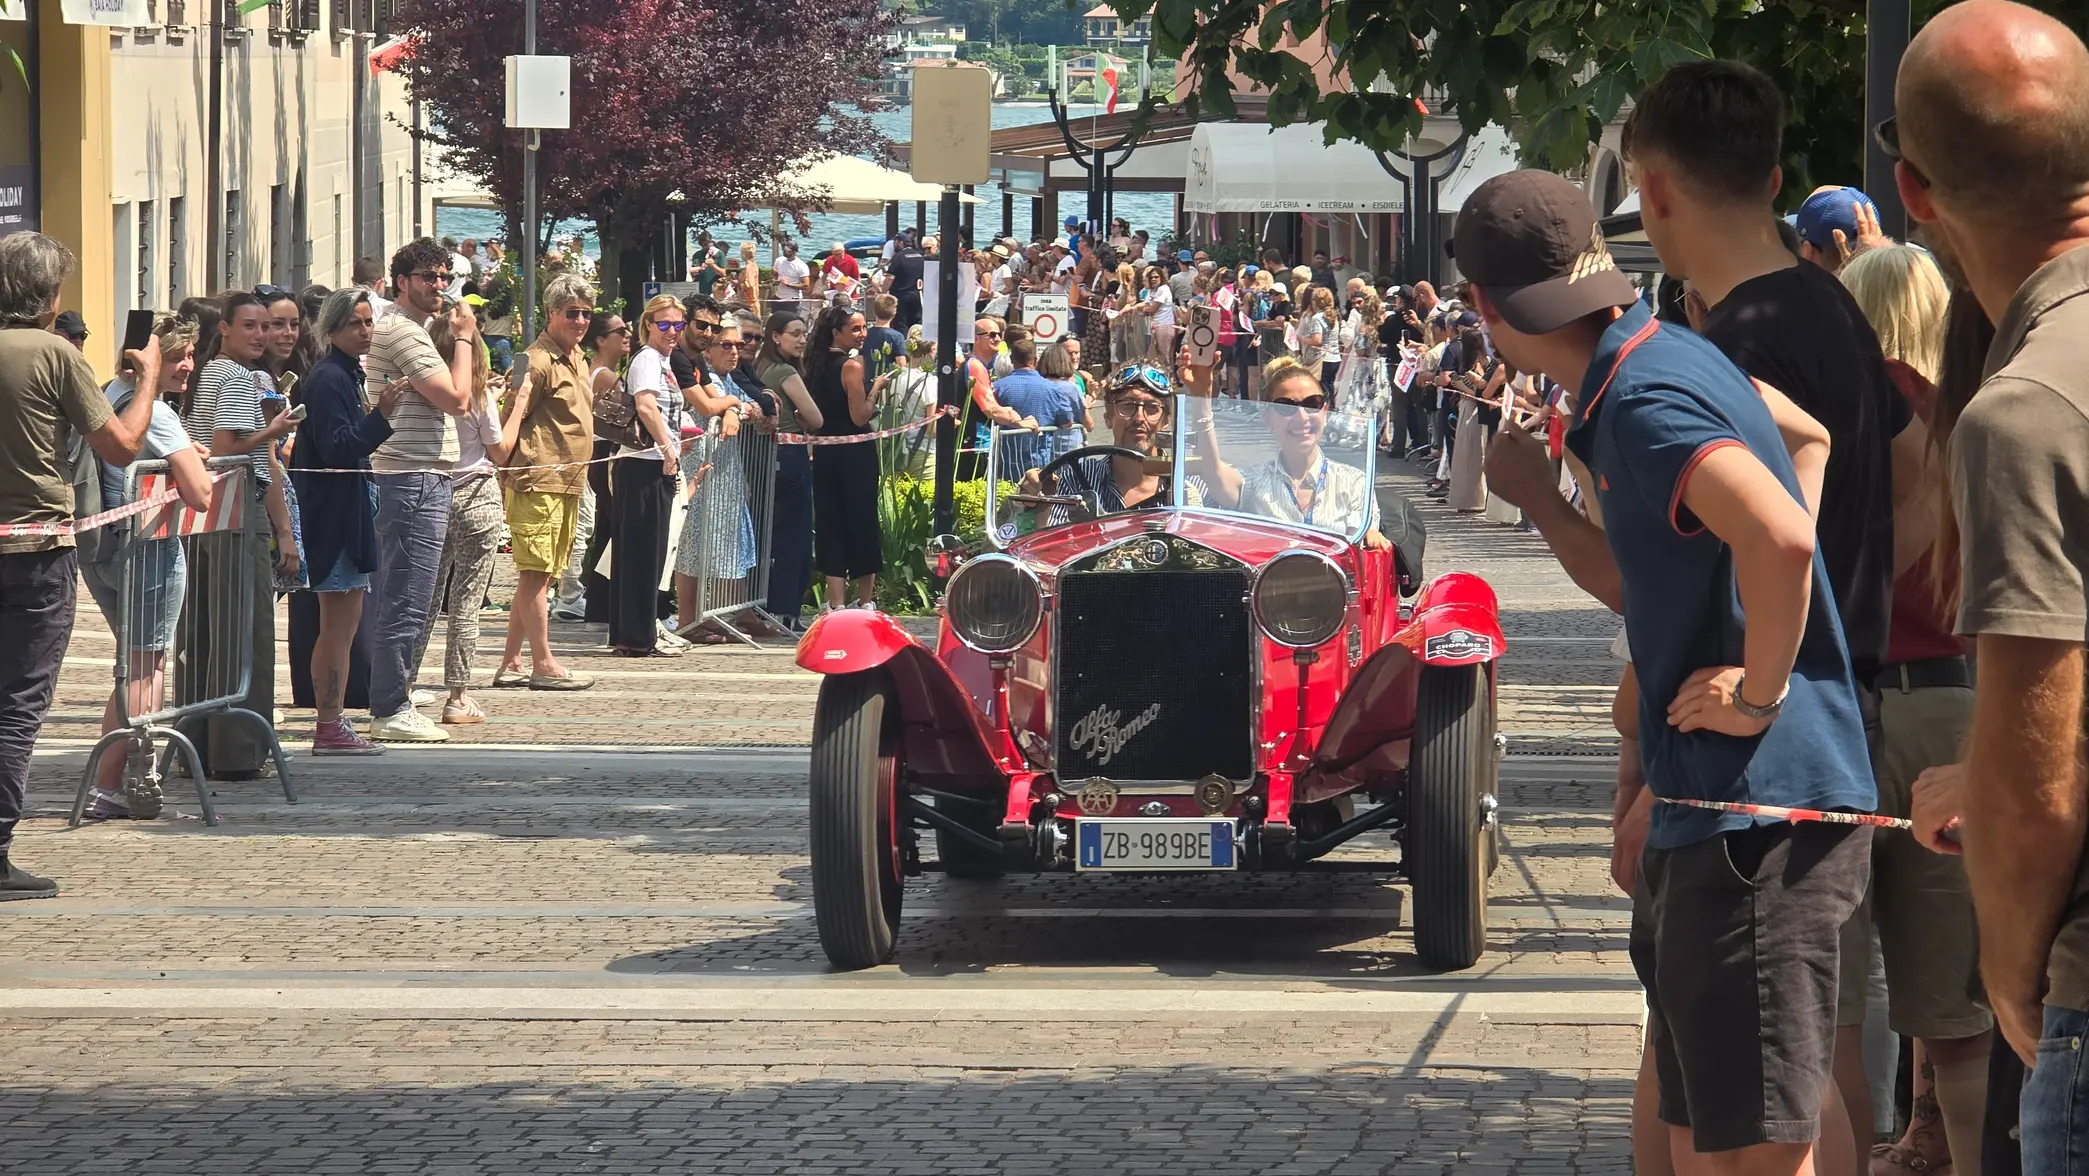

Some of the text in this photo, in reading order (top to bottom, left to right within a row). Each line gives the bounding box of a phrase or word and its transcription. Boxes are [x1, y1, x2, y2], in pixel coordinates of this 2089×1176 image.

[1260, 201, 1404, 209] GELATERIA ICECREAM EISDIELE
